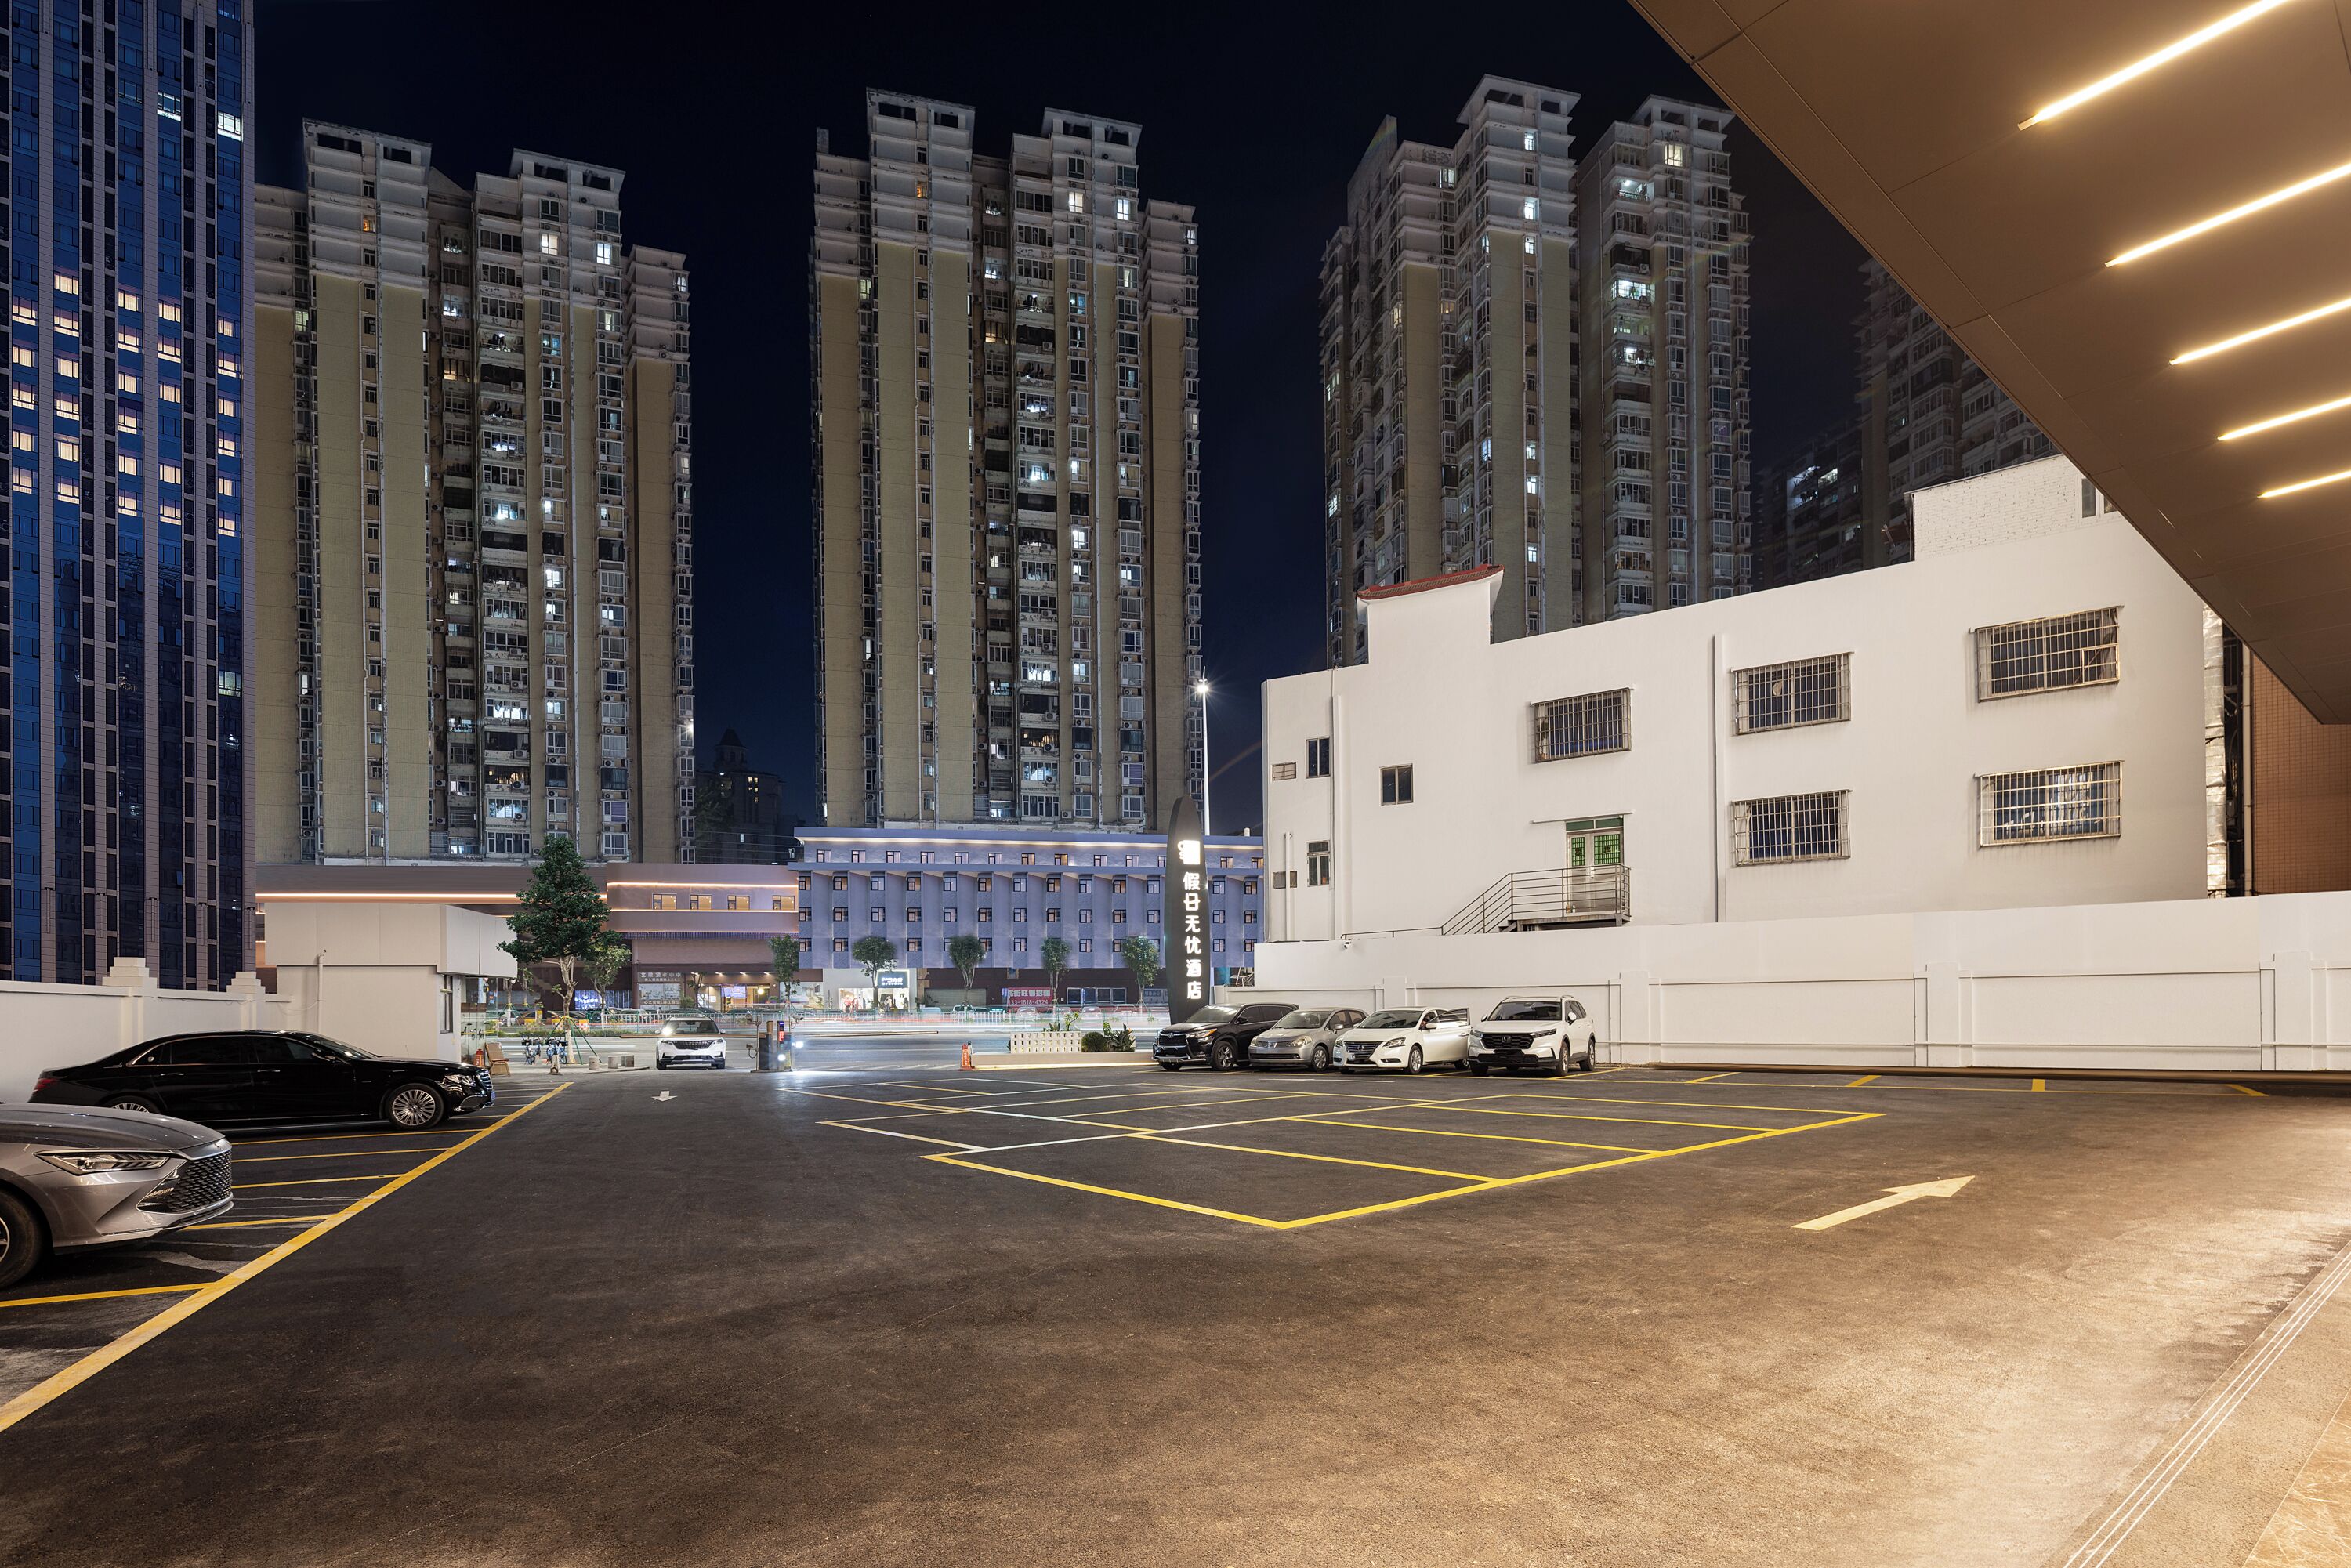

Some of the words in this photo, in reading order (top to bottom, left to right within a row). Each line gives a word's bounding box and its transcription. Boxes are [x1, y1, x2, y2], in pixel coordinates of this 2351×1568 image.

[1183, 871, 1202, 1000] 假日无忧酒店
